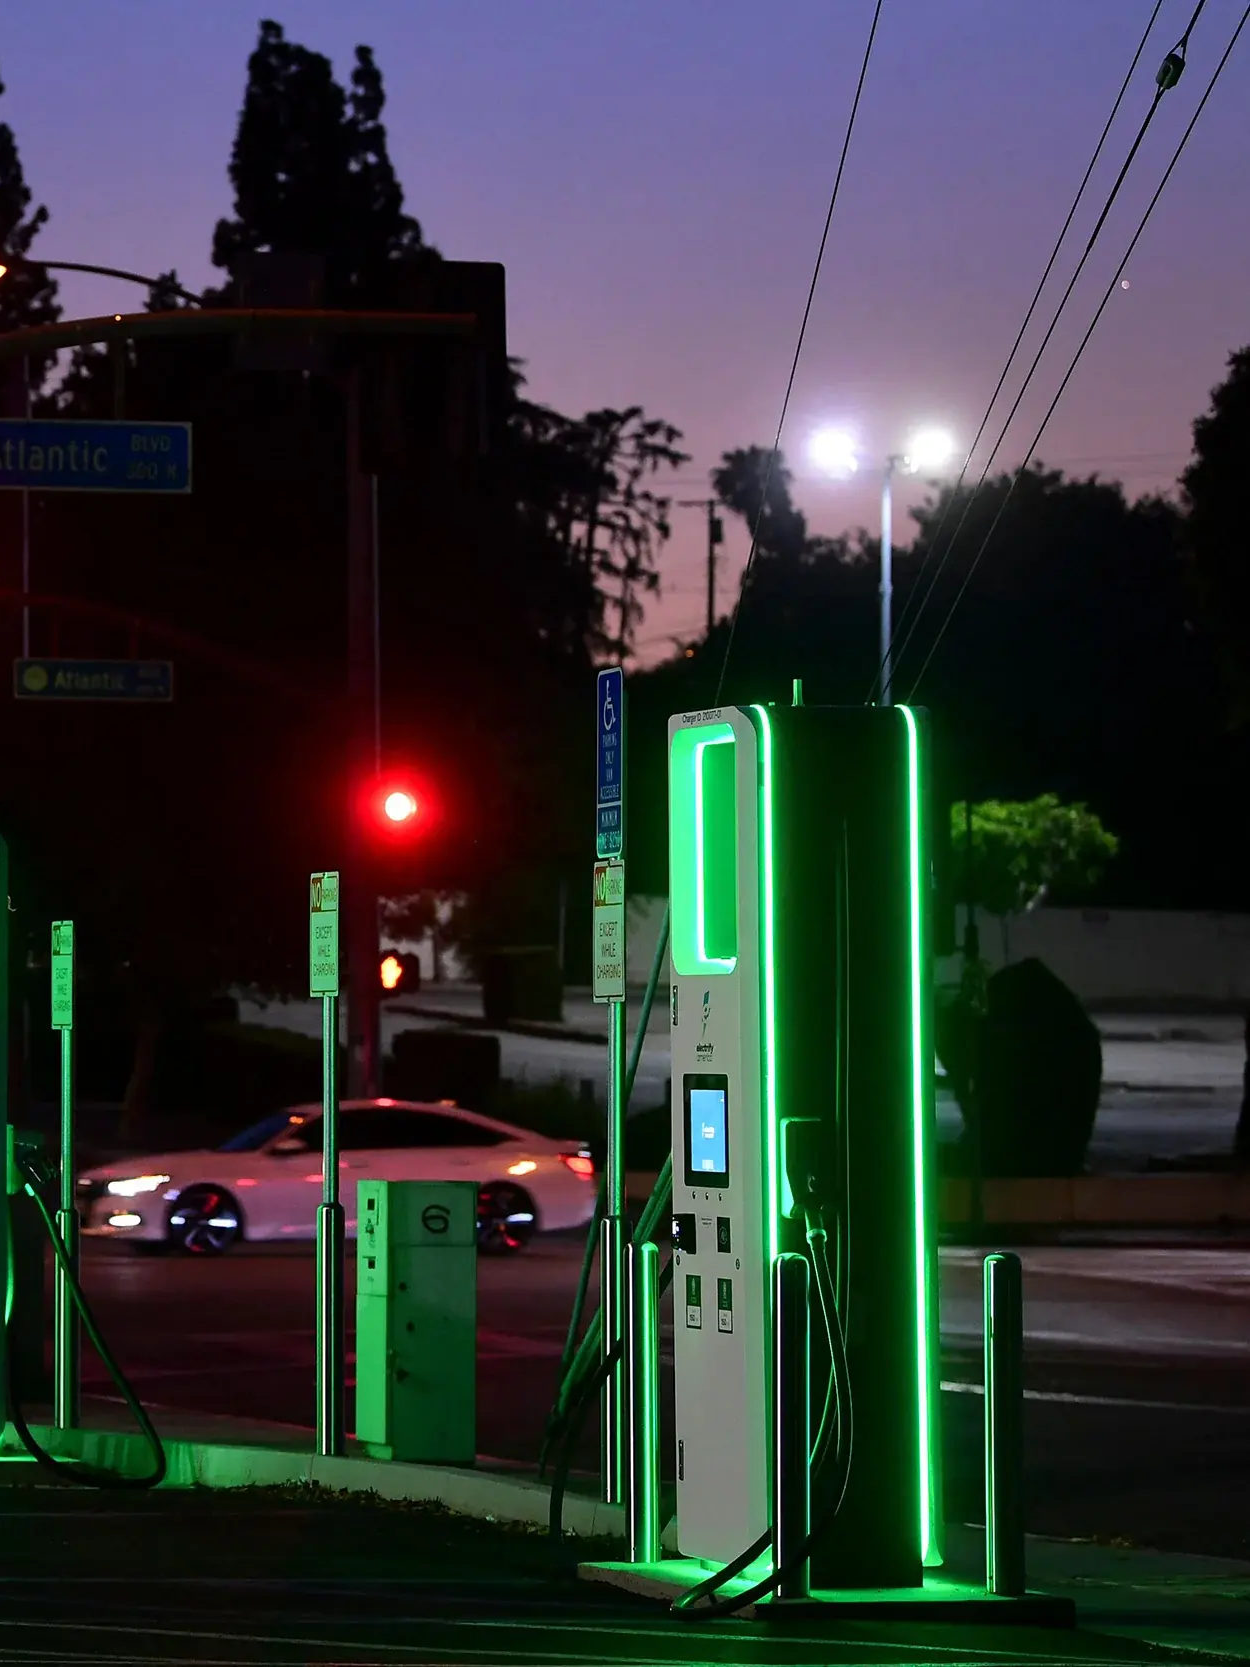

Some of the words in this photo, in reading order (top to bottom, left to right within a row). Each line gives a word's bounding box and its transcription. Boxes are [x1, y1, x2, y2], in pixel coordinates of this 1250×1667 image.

[131, 433, 172, 453] BLVD
[595, 872, 606, 900] NO
[311, 882, 321, 907] NO
[315, 926, 333, 940] EXCEPT
[599, 921, 618, 937] EXCEPT
[317, 944, 331, 958] WHILE
[601, 942, 616, 958] WHILE
[313, 963, 336, 977] CHARGING
[597, 963, 622, 979] CHARGING
[696, 1043, 715, 1054] electrify
